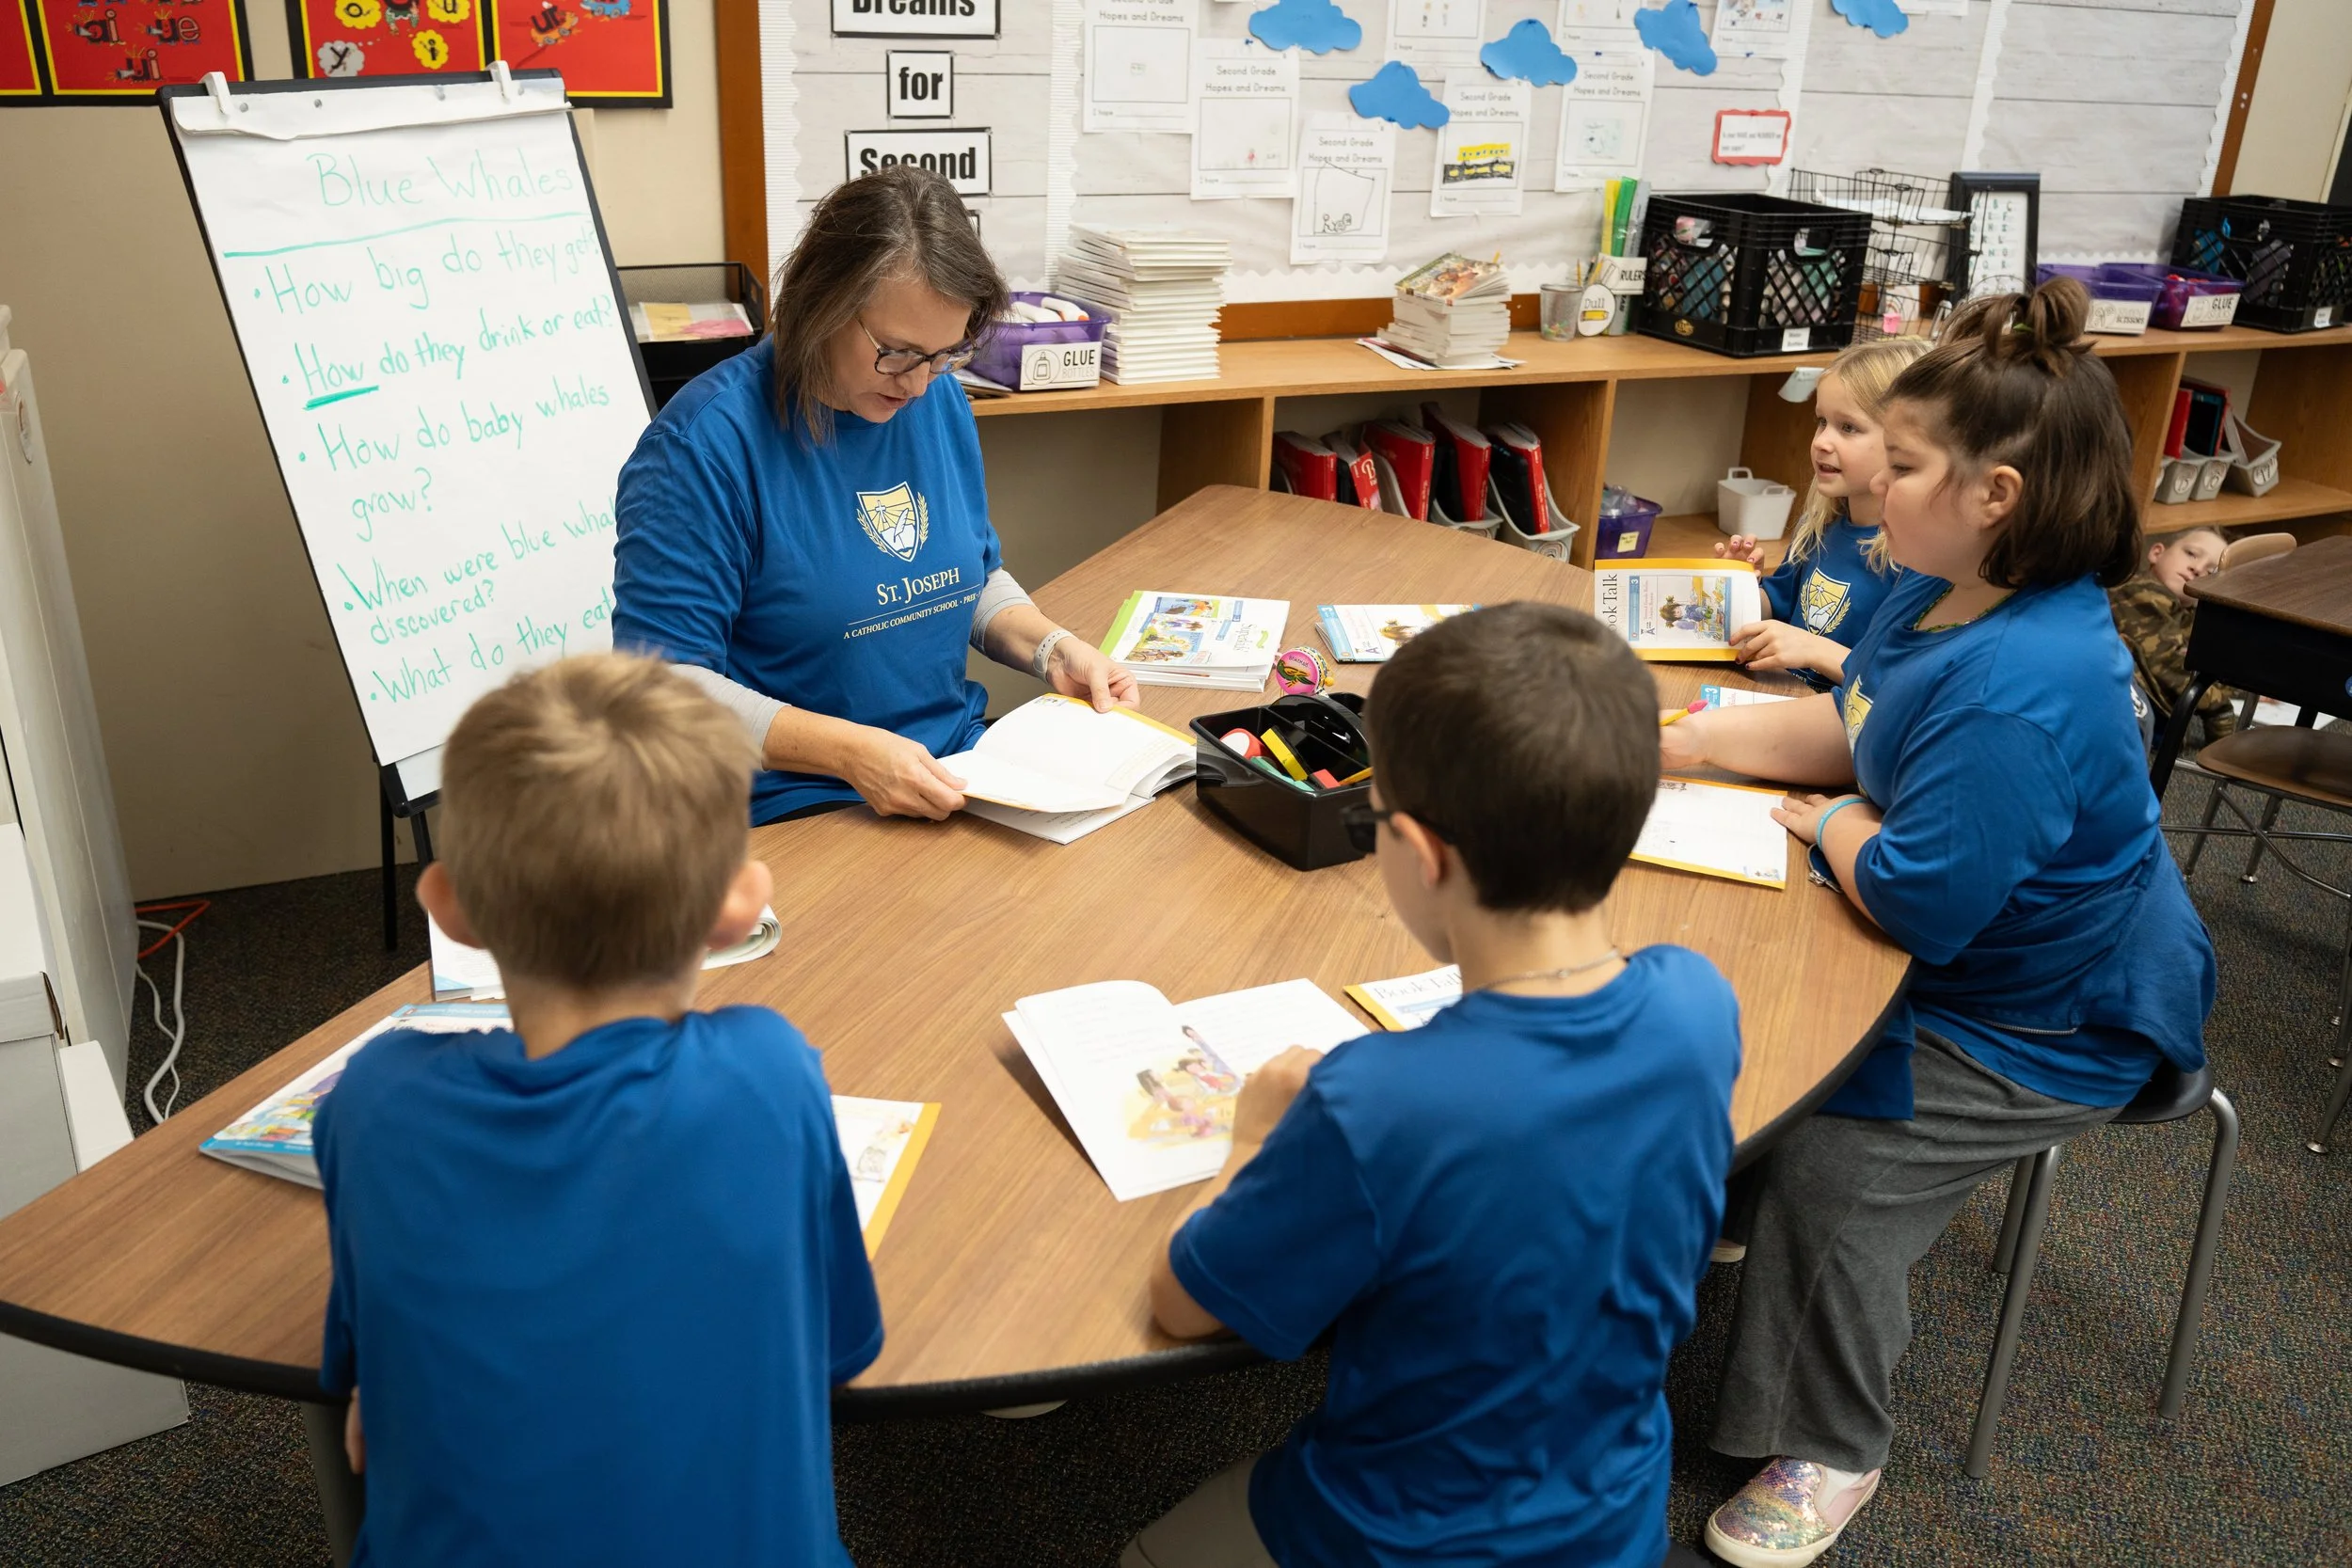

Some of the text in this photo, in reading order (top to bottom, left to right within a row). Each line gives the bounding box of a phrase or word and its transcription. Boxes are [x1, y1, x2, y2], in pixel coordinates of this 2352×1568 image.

[1099, 11, 1184, 23] Hopes and Dreams
[1216, 67, 1277, 77] Second Grade
[1583, 71, 1634, 81] Second Grade
[898, 67, 944, 100] for
[1205, 84, 1286, 93] Hopes and Dreams
[1573, 87, 1641, 97] Hopes and Dreams
[1460, 92, 1511, 102] Second Grade
[1489, 108, 1518, 117] Dreams
[1319, 137, 1374, 147] Second Grade
[860, 147, 976, 179] Second
[1336, 153, 1351, 163] and
[1353, 153, 1383, 163] Dreams
[307, 148, 574, 206] Blue Whales
[265, 220, 600, 313] How big do they get?
[1584, 298, 1605, 309] Dull
[2212, 297, 2233, 310] GLUE
[295, 294, 613, 395] How do they drink or eat?
[1063, 349, 1095, 366] GLUE
[1062, 367, 1095, 378] BOTTLES
[317, 374, 610, 471] How do baby whales
[351, 467, 433, 543] grow?
[337, 495, 616, 610] When were blue whal
[370, 578, 495, 645] discovered?
[1602, 574, 1617, 631] ook Talk
[844, 631, 850, 640] A
[851, 620, 889, 638] CATHOLIC
[889, 608, 932, 627] COMMUNITY
[932, 599, 959, 612] SCHOOL
[372, 586, 612, 704] What do they eat
[1374, 981, 1427, 1000] Book
